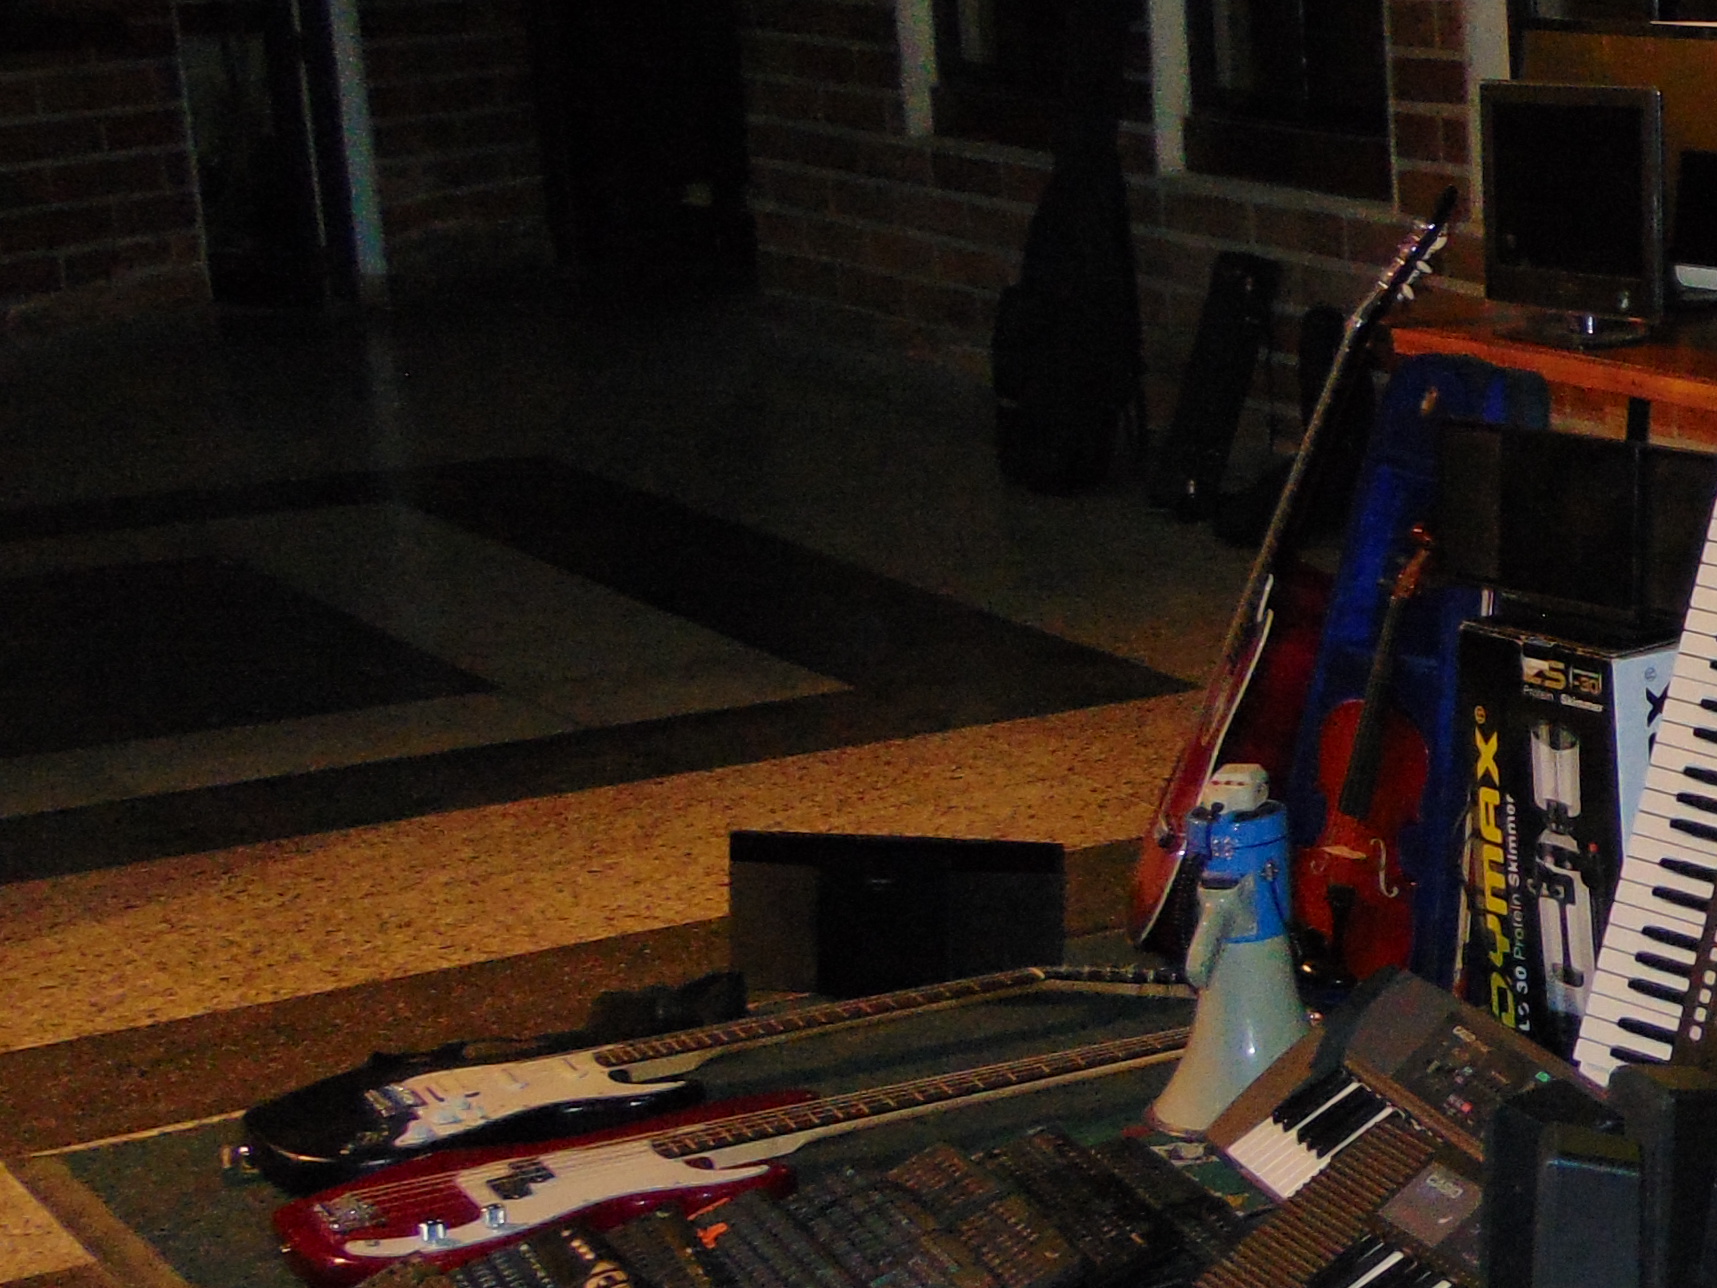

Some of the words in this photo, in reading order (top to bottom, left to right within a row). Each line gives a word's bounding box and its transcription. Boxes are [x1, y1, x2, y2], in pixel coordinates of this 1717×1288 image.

[1475, 725, 1517, 1030] DYMAX
[1505, 794, 1520, 888] Skimmer
[1513, 893, 1527, 960] Protein
[1515, 966, 1527, 994] 30
